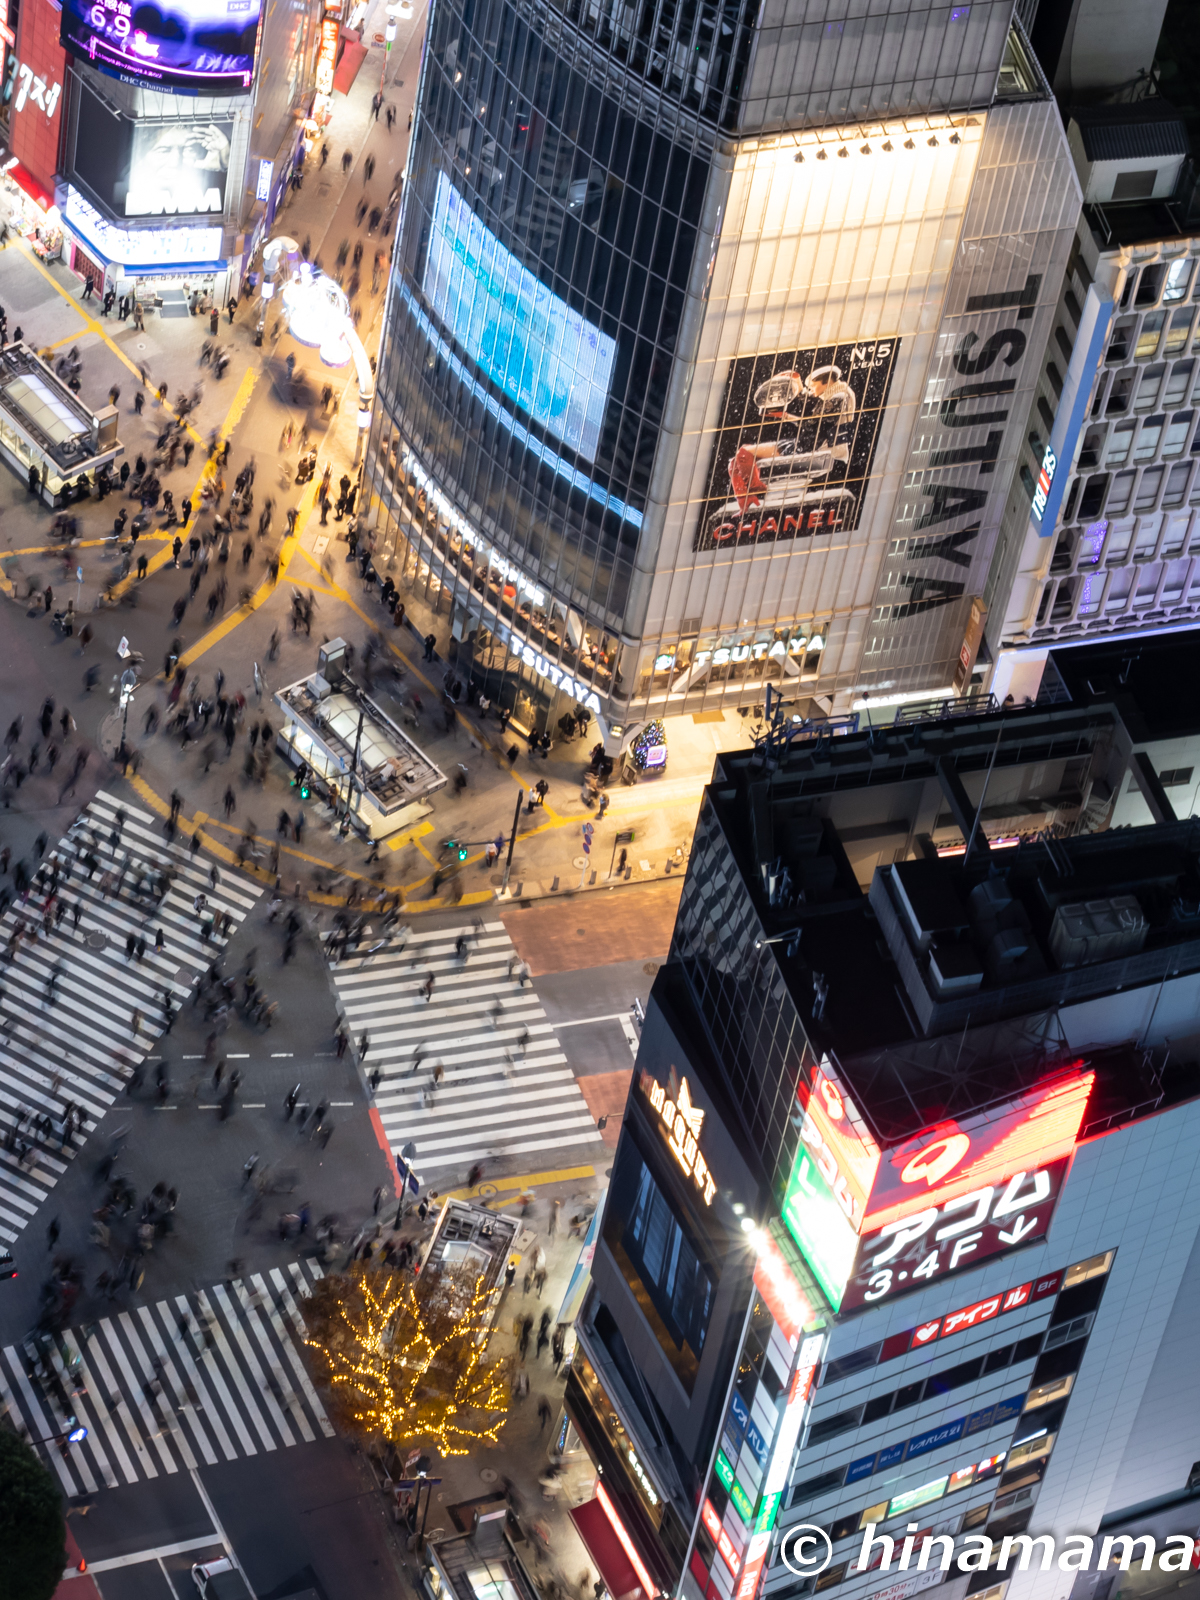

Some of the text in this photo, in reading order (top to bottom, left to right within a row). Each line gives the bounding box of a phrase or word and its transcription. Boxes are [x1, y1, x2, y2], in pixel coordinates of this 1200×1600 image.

[91, 5, 131, 38] 6.9
[14, 63, 62, 118] クスリ
[119, 74, 174, 95] DHC Channel
[891, 273, 1043, 621] TSUTAYA
[713, 509, 843, 541] CHANEL
[696, 634, 825, 665] TSUTAYA
[510, 634, 601, 714] TSUTAYA
[872, 1169, 1050, 1267] アコム
[945, 1286, 1027, 1333] アイフル
[922, 1572, 941, 1585] 3F
